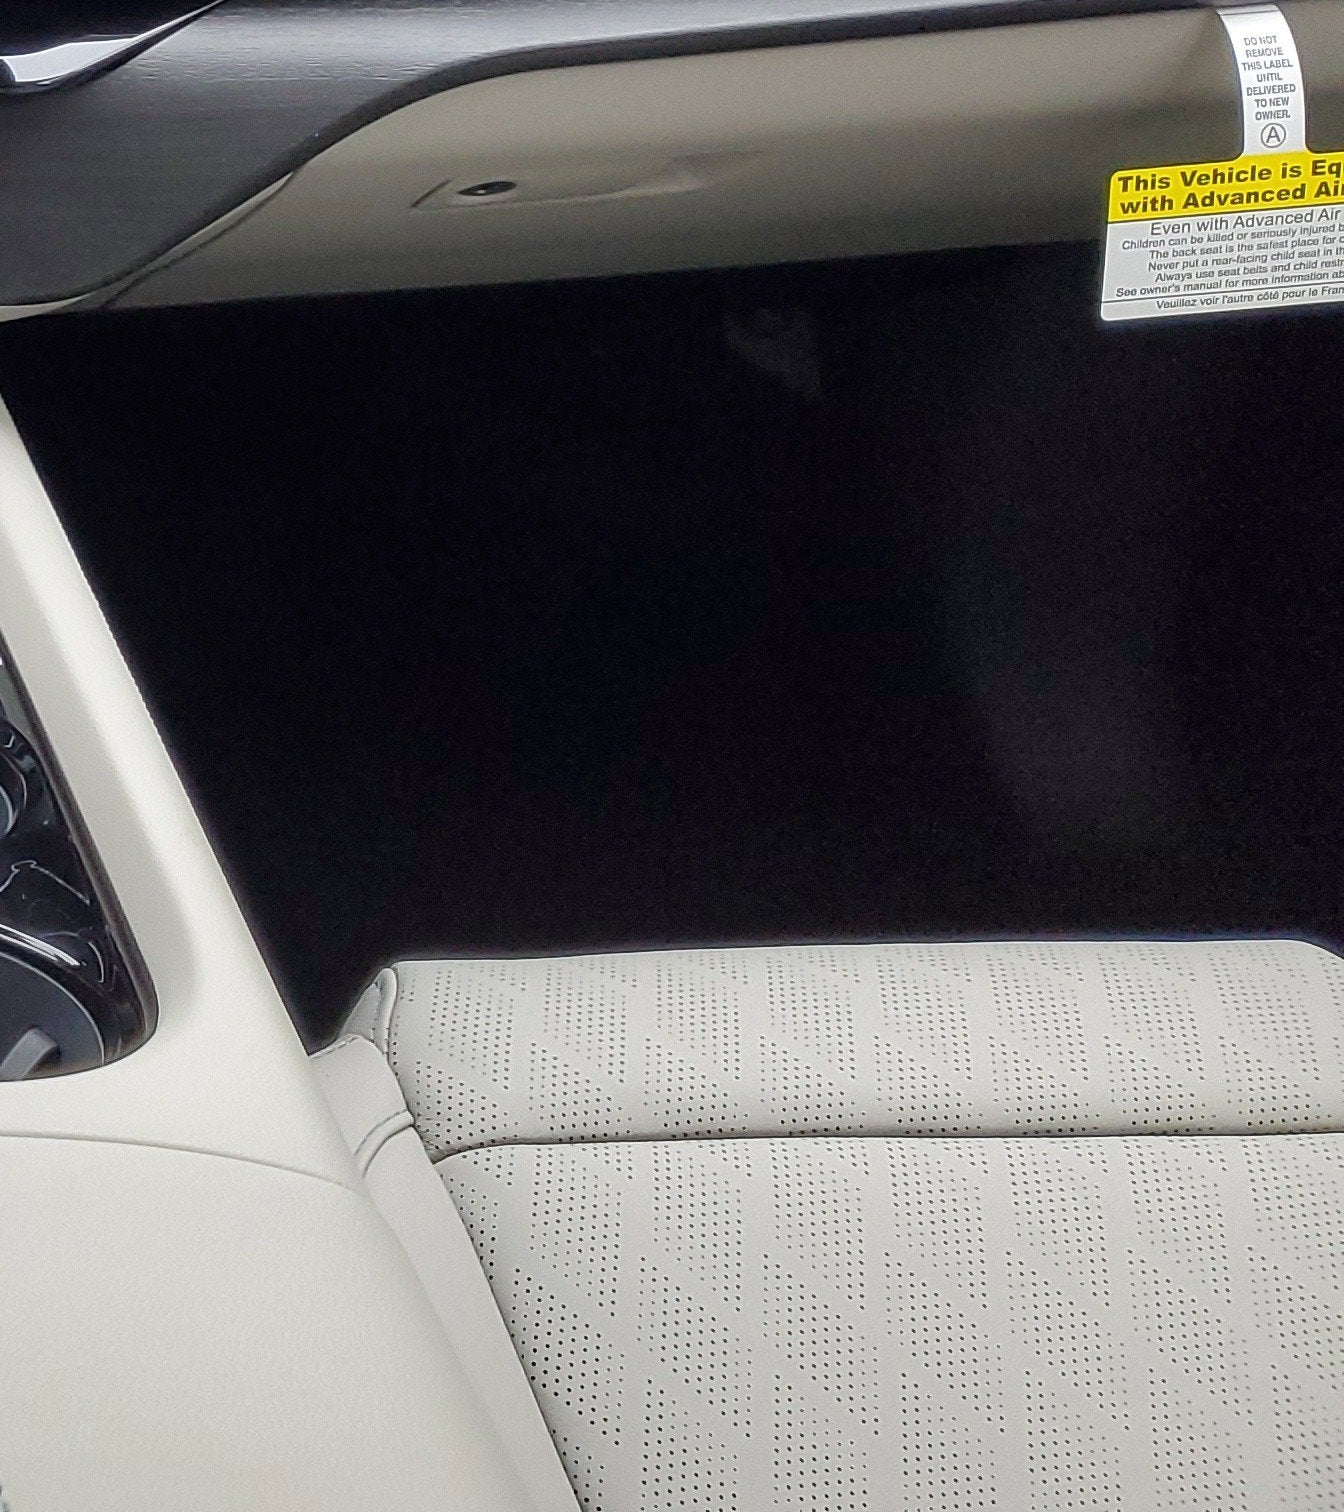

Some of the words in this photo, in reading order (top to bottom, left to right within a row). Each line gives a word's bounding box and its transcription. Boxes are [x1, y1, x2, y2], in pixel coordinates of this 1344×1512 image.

[1244, 37, 1257, 46] DO
[1245, 47, 1284, 58] REMOVE
[1241, 61, 1262, 71] THIS
[1264, 59, 1294, 69] LABEL
[1246, 84, 1296, 96] DELIVERED
[1254, 98, 1267, 108] TO
[1269, 97, 1290, 107] NEW
[1266, 126, 1281, 143] A
[1118, 174, 1171, 193] This
[1180, 165, 1272, 187] Vehicle
[1281, 162, 1302, 179] is
[1120, 195, 1174, 215] with
[1182, 183, 1306, 209] Advanced
[1150, 221, 1191, 236] Even
[1197, 217, 1229, 232] with
[1233, 209, 1314, 229] Advanced
[1318, 208, 1341, 222] Air
[1122, 238, 1166, 251] Children
[1168, 237, 1188, 246] can
[1190, 235, 1204, 245] be
[1206, 232, 1234, 243] killed
[1237, 231, 1248, 240] or
[1250, 227, 1297, 239] seriously
[1300, 223, 1336, 236] injured
[1150, 249, 1169, 260] The
[1172, 247, 1197, 258] back
[1200, 245, 1223, 256] seat
[1225, 244, 1234, 253] is
[1237, 242, 1254, 252] the
[1257, 240, 1288, 251] safest
[1291, 237, 1319, 249] place
[1322, 236, 1336, 245] for
[1148, 260, 1179, 272] Never
[1182, 259, 1199, 270] put
[1202, 259, 1209, 267] a
[1211, 253, 1268, 266] rear-facing
[1271, 250, 1295, 261] child
[1298, 248, 1320, 258] seat
[1323, 248, 1332, 256] in
[1155, 271, 1193, 283] Always
[1195, 270, 1215, 278] use
[1217, 266, 1240, 277] seat
[1243, 264, 1268, 275] belts
[1271, 262, 1291, 272] and
[1293, 260, 1318, 271] child
[1116, 288, 1137, 297] See
[1140, 284, 1181, 296] owner's
[1183, 279, 1223, 292] manual
[1225, 277, 1239, 289] for
[1241, 277, 1269, 287] more
[1271, 271, 1329, 285] information
[1156, 297, 1197, 310] Veuillez
[1200, 294, 1220, 306] voir
[1282, 289, 1306, 301] pour
[1308, 287, 1319, 297] le
